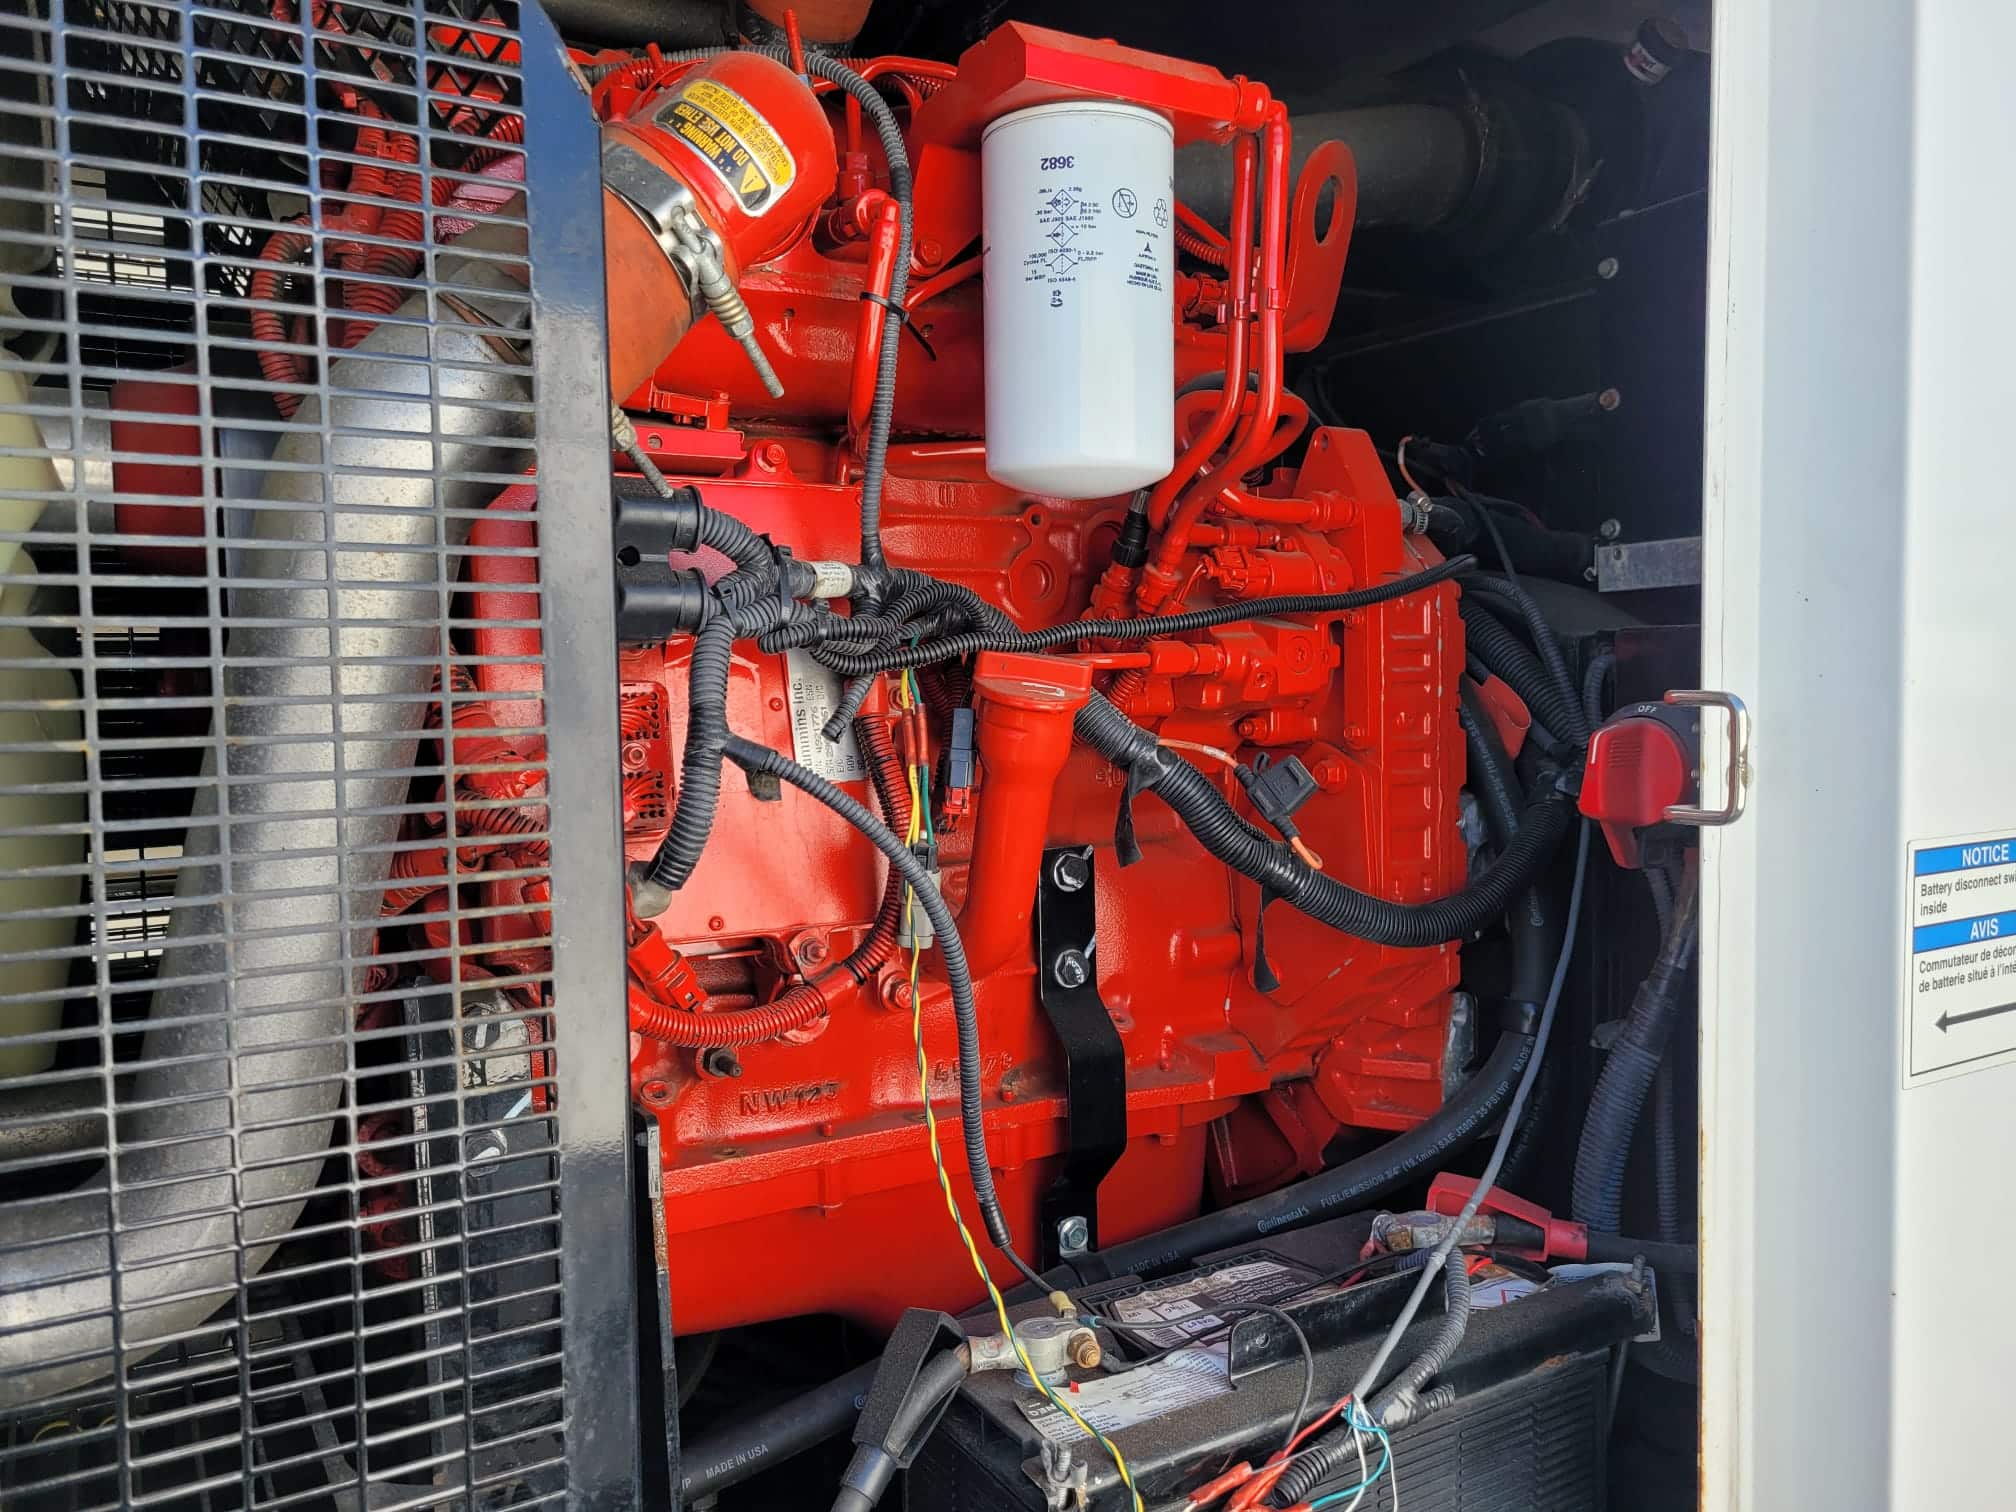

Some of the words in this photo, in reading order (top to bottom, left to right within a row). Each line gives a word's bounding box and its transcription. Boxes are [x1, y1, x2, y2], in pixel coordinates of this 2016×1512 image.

[698, 116, 721, 137] USE
[680, 122, 722, 160] WARNING
[714, 131, 738, 153] NOT
[732, 148, 750, 167] DO
[1040, 155, 1075, 171] 3682
[792, 677, 804, 704] Inc.
[1637, 704, 1657, 713] OFF
[796, 708, 813, 770] ummins
[1962, 843, 2010, 867] NOTICE
[1920, 881, 1953, 897] Battery
[1954, 873, 2001, 891] disconnect
[1920, 900, 1948, 916] inside
[1970, 918, 1999, 941] AVIS
[1919, 952, 1979, 974] Commutateur
[1981, 948, 1991, 961] de
[1919, 981, 1930, 993] de
[1932, 973, 1966, 991] batterie
[1967, 967, 1989, 983] situé
[1257, 1207, 1305, 1233] Continental
[705, 1458, 735, 1481] MADE
[735, 1452, 747, 1467] IN
[747, 1443, 769, 1461] USA
